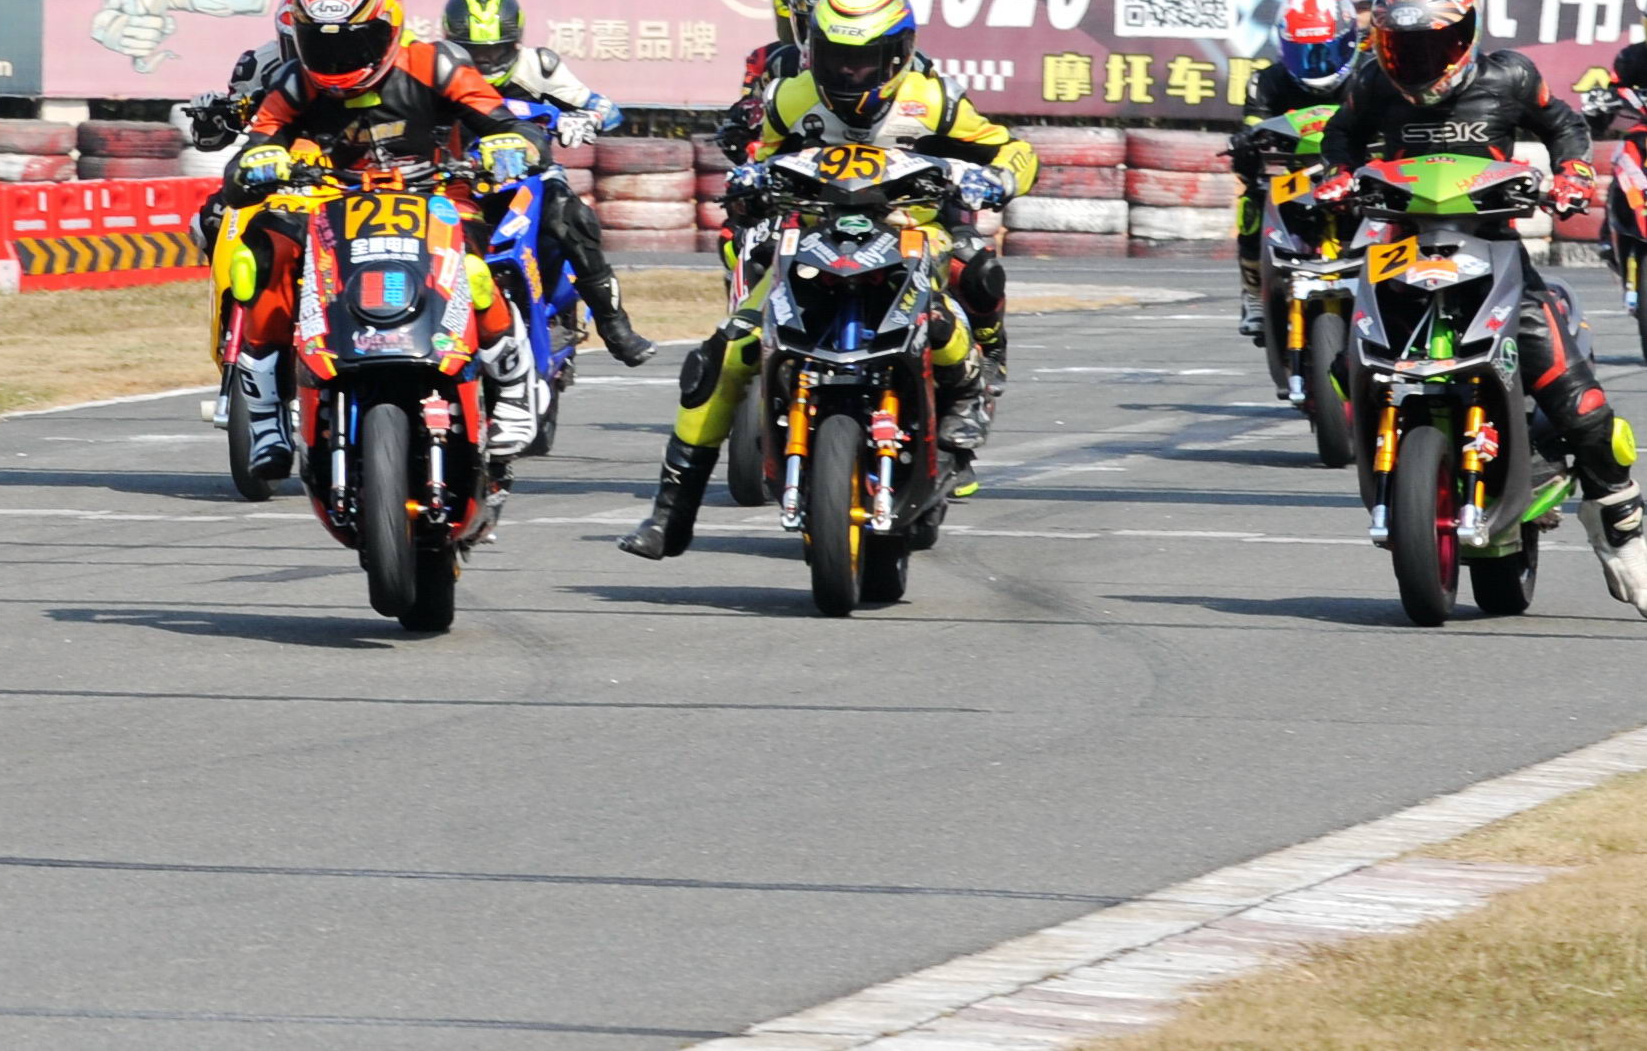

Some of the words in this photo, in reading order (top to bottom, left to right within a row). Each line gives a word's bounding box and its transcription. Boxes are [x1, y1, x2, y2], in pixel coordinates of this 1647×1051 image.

[313, 1, 345, 14] Arai
[546, 18, 721, 63] 减震品牌
[819, 146, 881, 181] 95
[1281, 177, 1297, 195] 1
[351, 195, 421, 239] 25
[1379, 244, 1409, 276] 2
